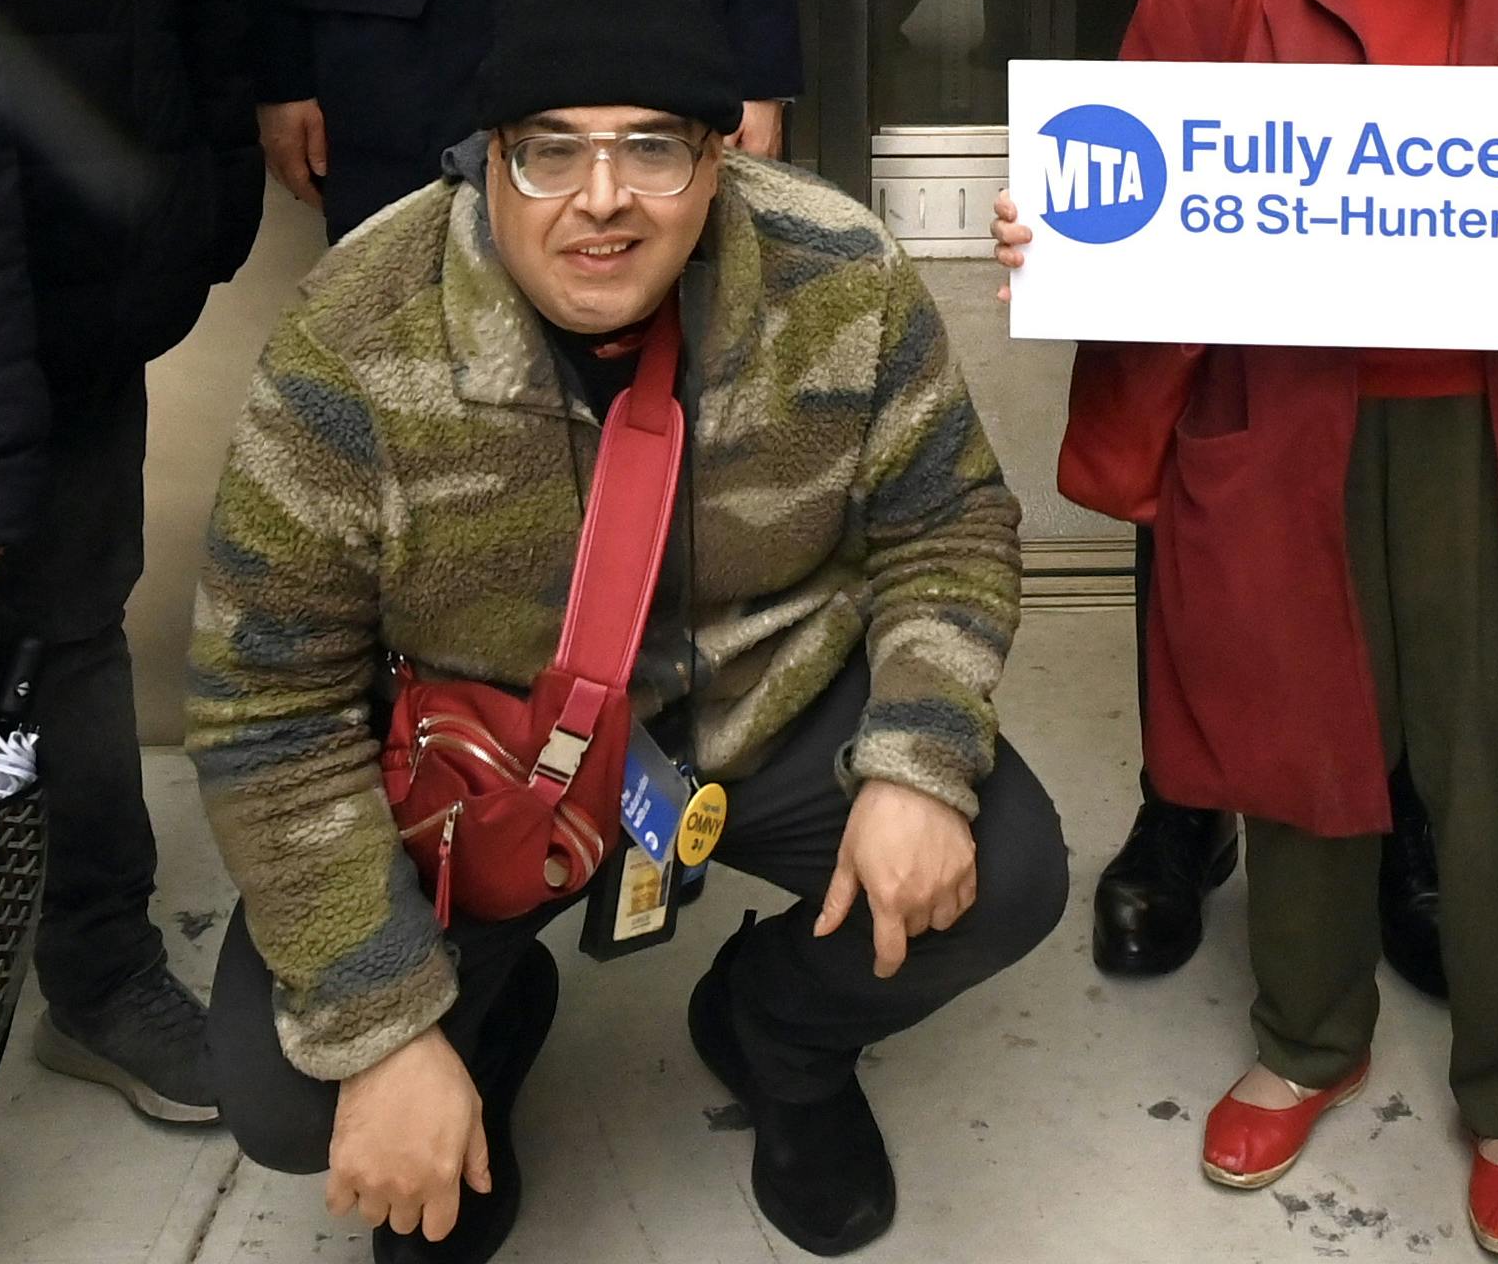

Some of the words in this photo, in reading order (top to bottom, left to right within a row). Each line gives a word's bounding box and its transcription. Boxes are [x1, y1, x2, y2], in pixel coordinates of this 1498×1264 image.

[1042, 134, 1144, 214] MTA
[1183, 120, 1332, 186] Fully
[1181, 194, 1244, 233] 68
